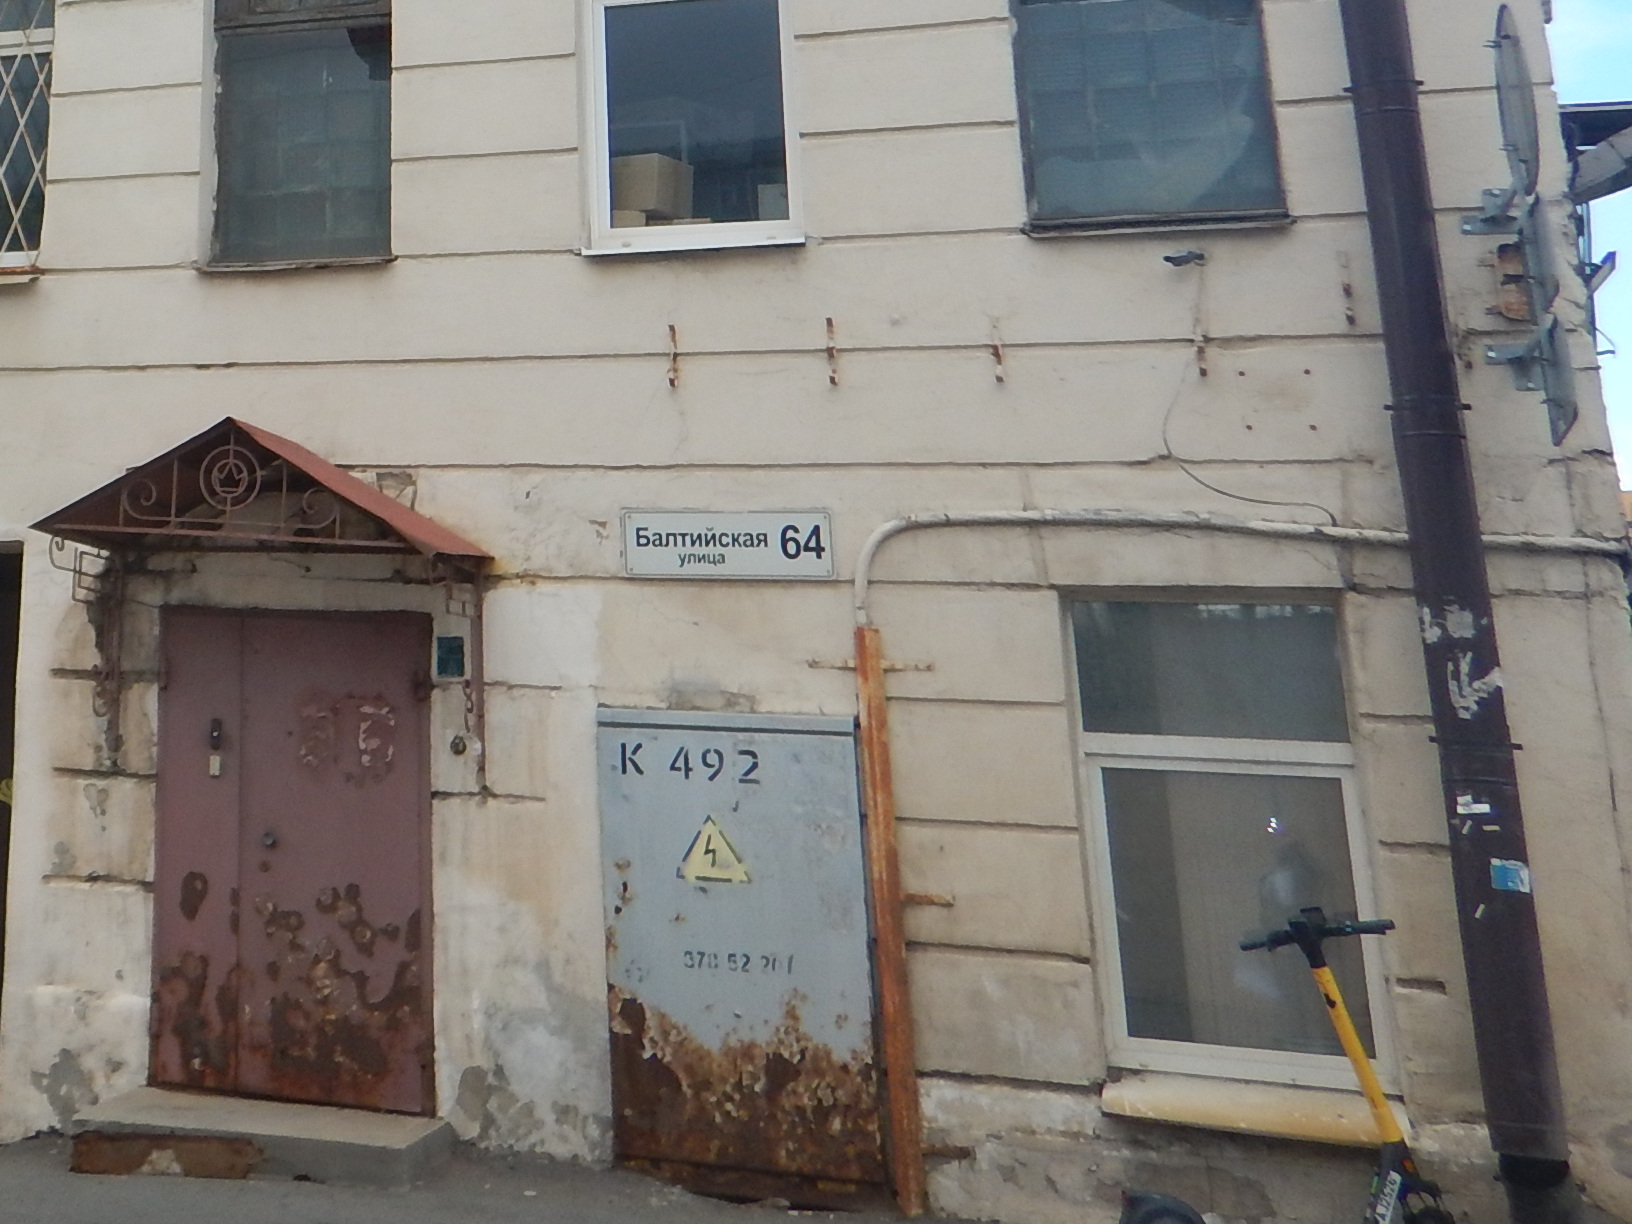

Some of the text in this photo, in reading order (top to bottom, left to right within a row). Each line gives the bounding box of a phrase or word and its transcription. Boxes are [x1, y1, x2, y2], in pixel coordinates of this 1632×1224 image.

[635, 527, 768, 548] Балтийская
[780, 524, 826, 560] 64
[678, 551, 726, 568] улица
[669, 746, 760, 785] 492
